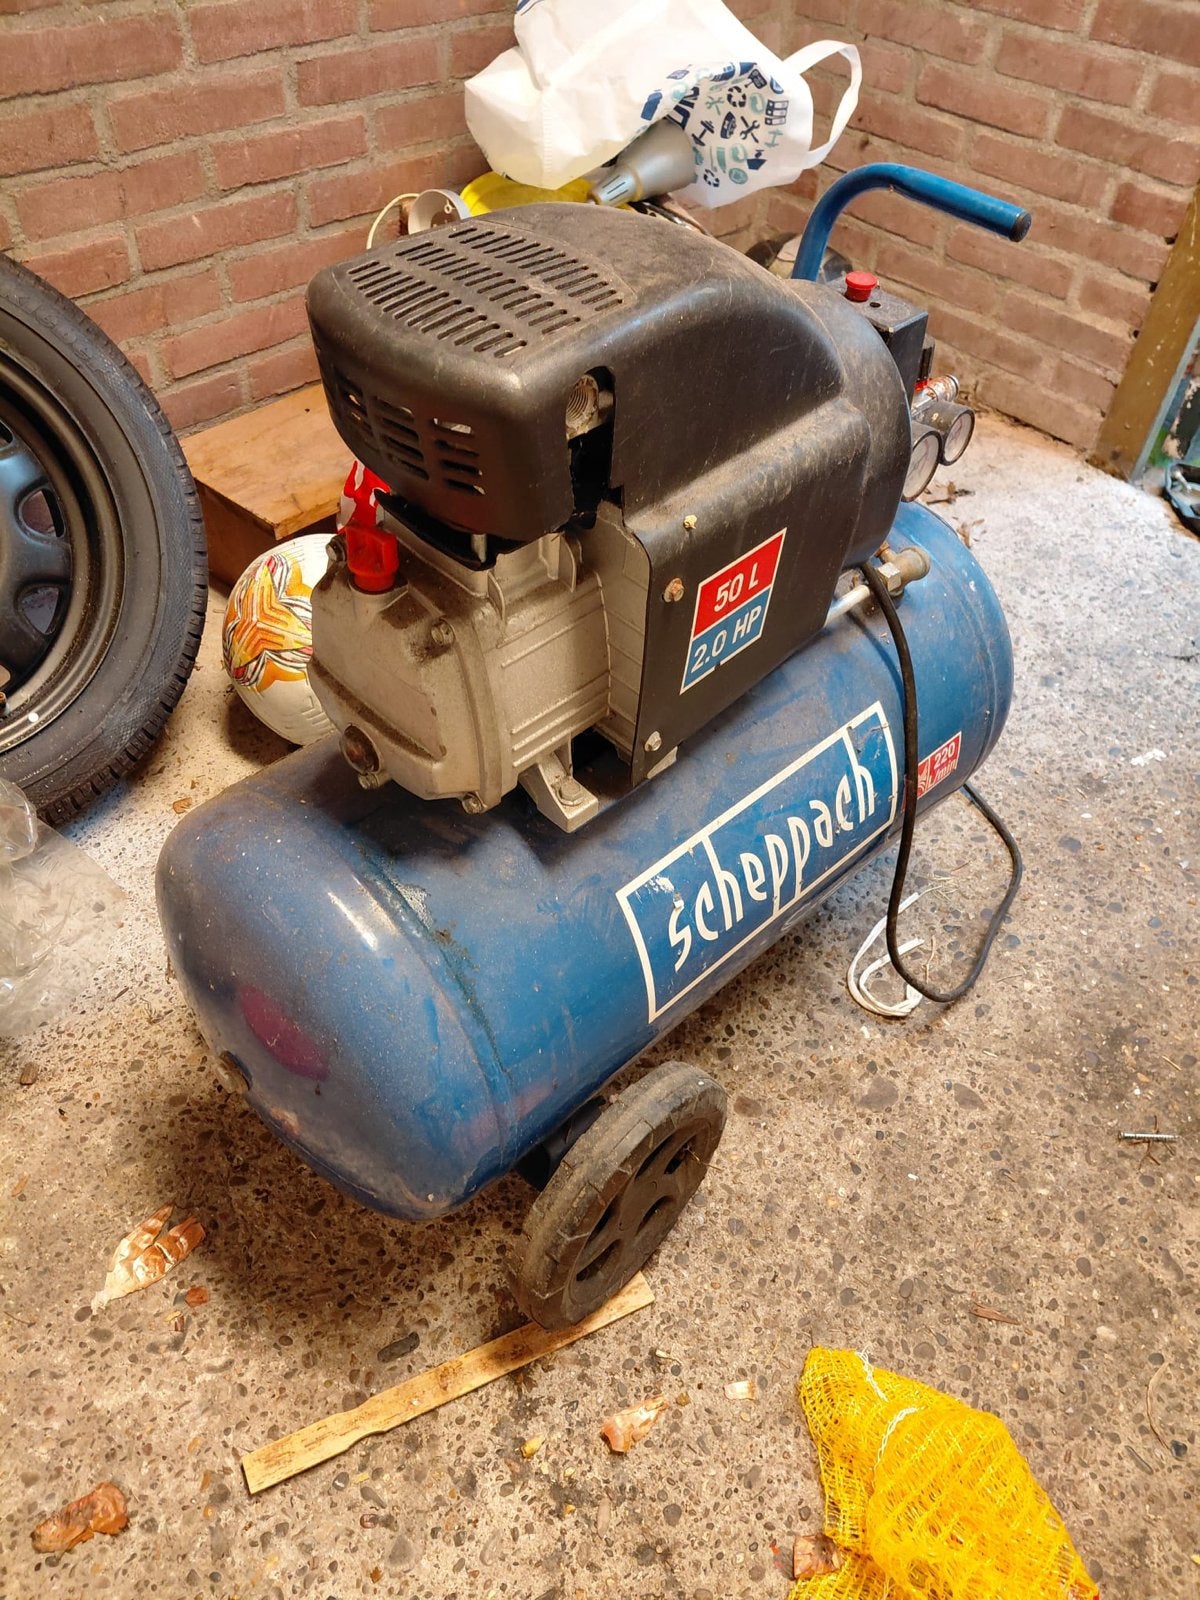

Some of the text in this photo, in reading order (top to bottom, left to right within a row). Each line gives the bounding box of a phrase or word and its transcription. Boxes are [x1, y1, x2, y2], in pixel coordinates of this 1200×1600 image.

[714, 562, 759, 612] 50 L
[691, 605, 762, 674] 2.0 HP
[934, 741, 956, 770] 220
[667, 726, 875, 973] scheppach
